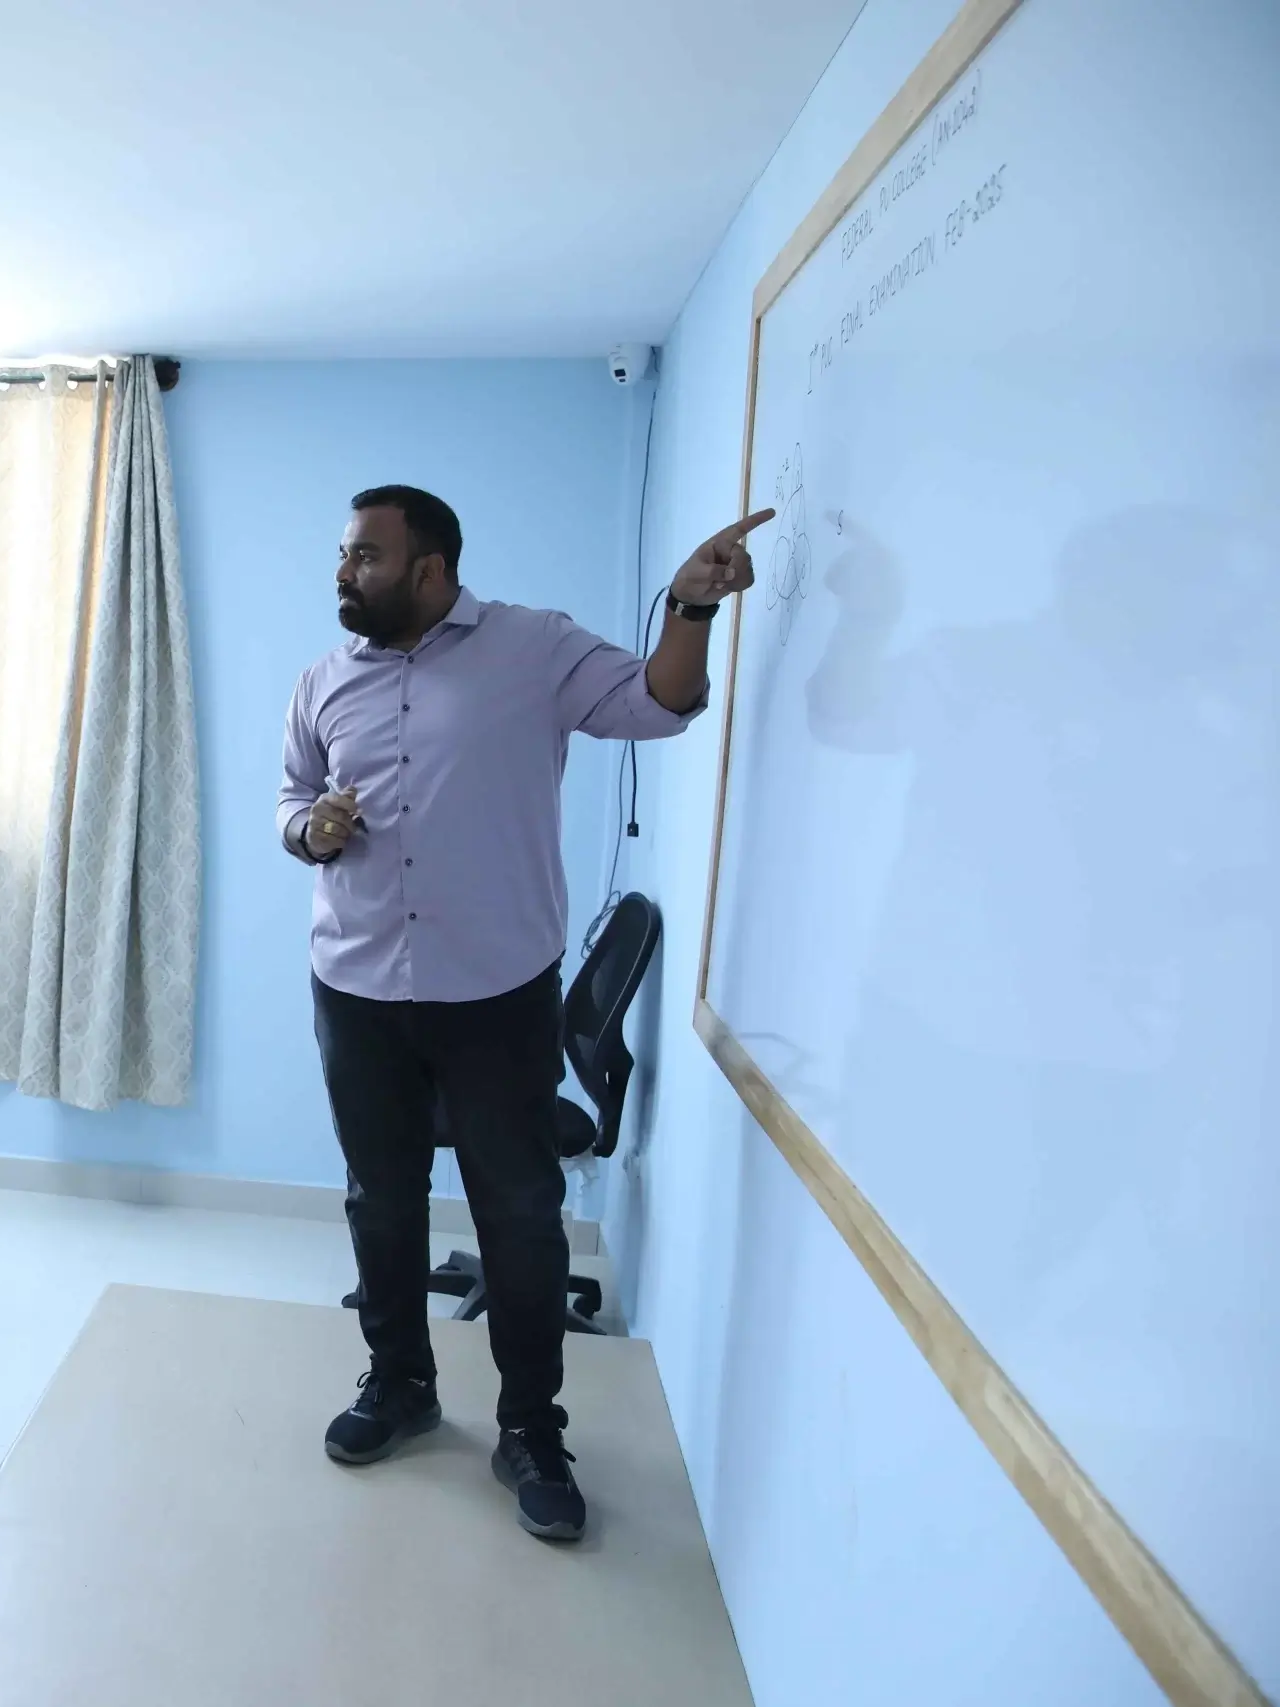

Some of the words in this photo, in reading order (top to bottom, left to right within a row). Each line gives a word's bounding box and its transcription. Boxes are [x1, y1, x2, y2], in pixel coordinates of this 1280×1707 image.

[841, 206, 874, 268] FEDERAL
[891, 144, 927, 201] COLLEGE
[840, 299, 864, 350] FINAL
